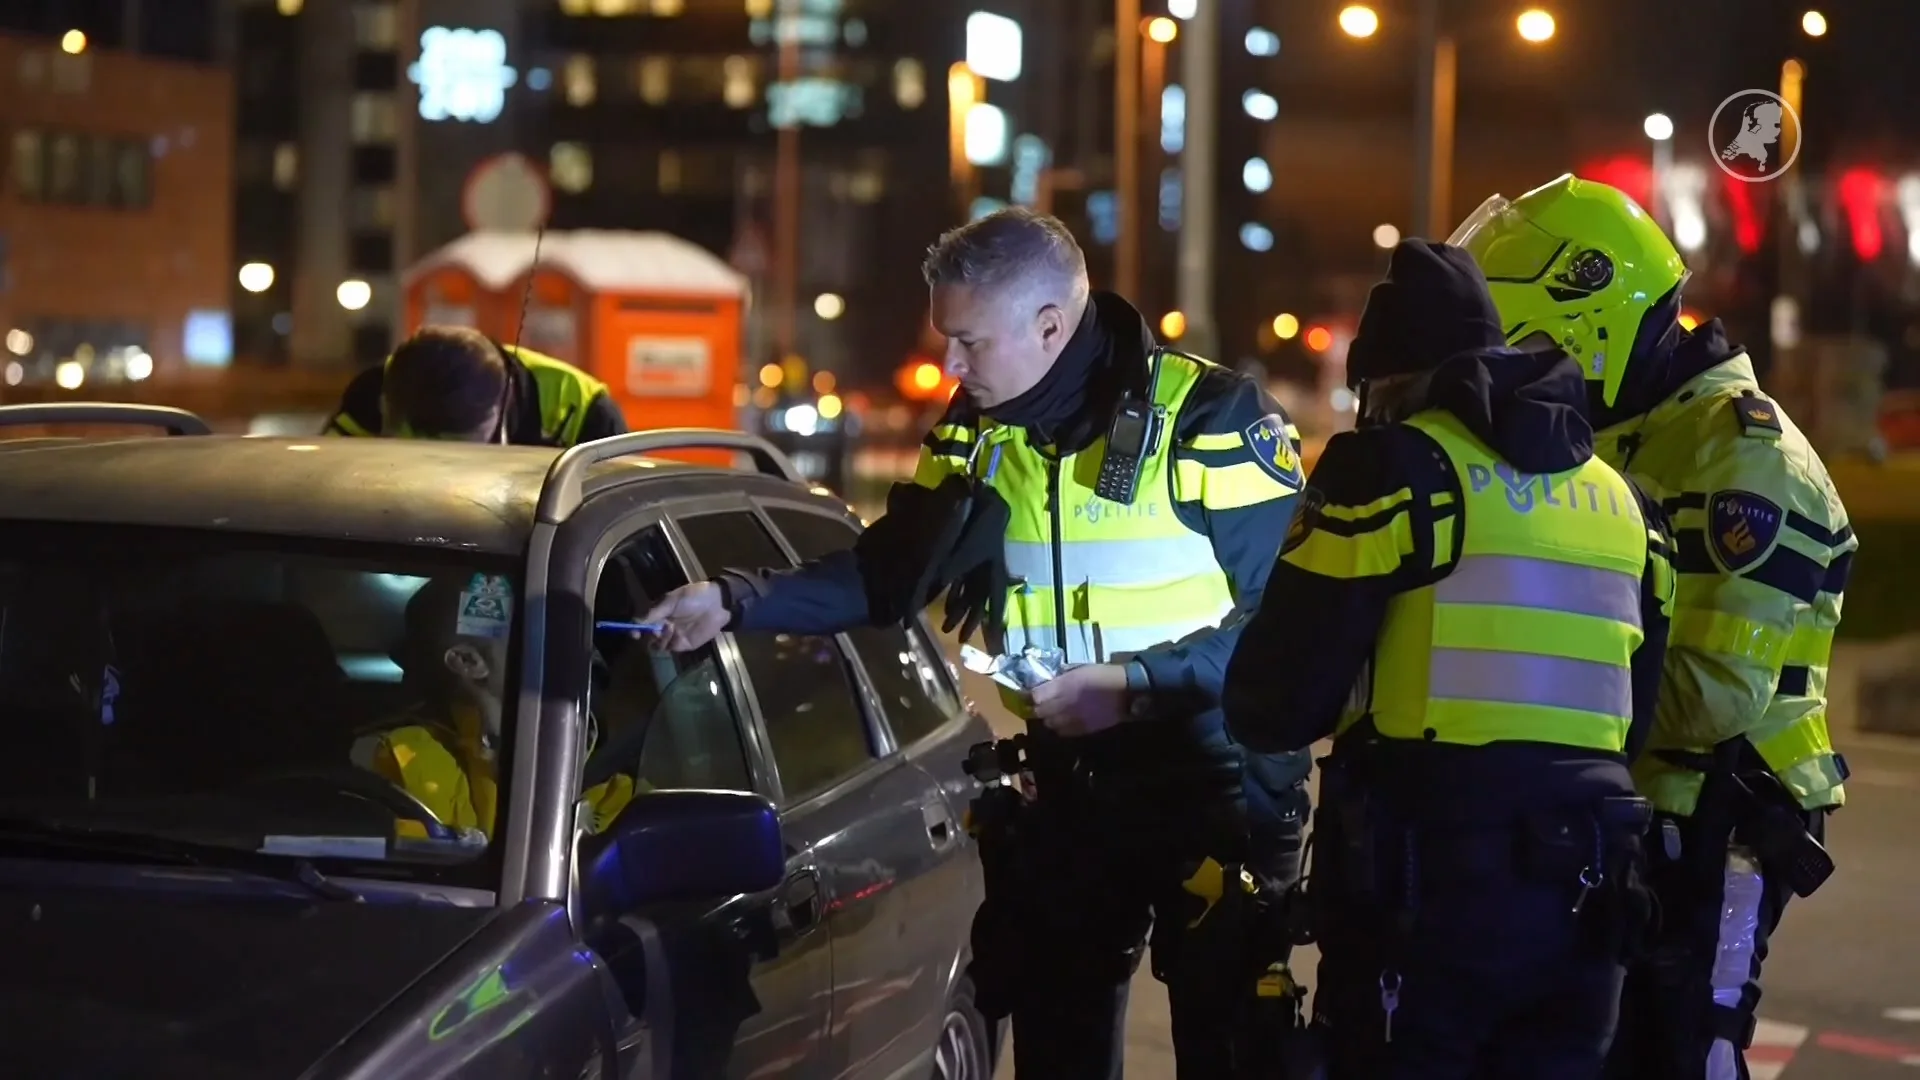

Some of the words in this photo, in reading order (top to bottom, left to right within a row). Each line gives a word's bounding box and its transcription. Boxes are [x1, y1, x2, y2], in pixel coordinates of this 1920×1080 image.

[1466, 462, 1641, 523] POLITIE
[1074, 496, 1157, 523] POLITIE
[1718, 499, 1774, 523] POLITIE
